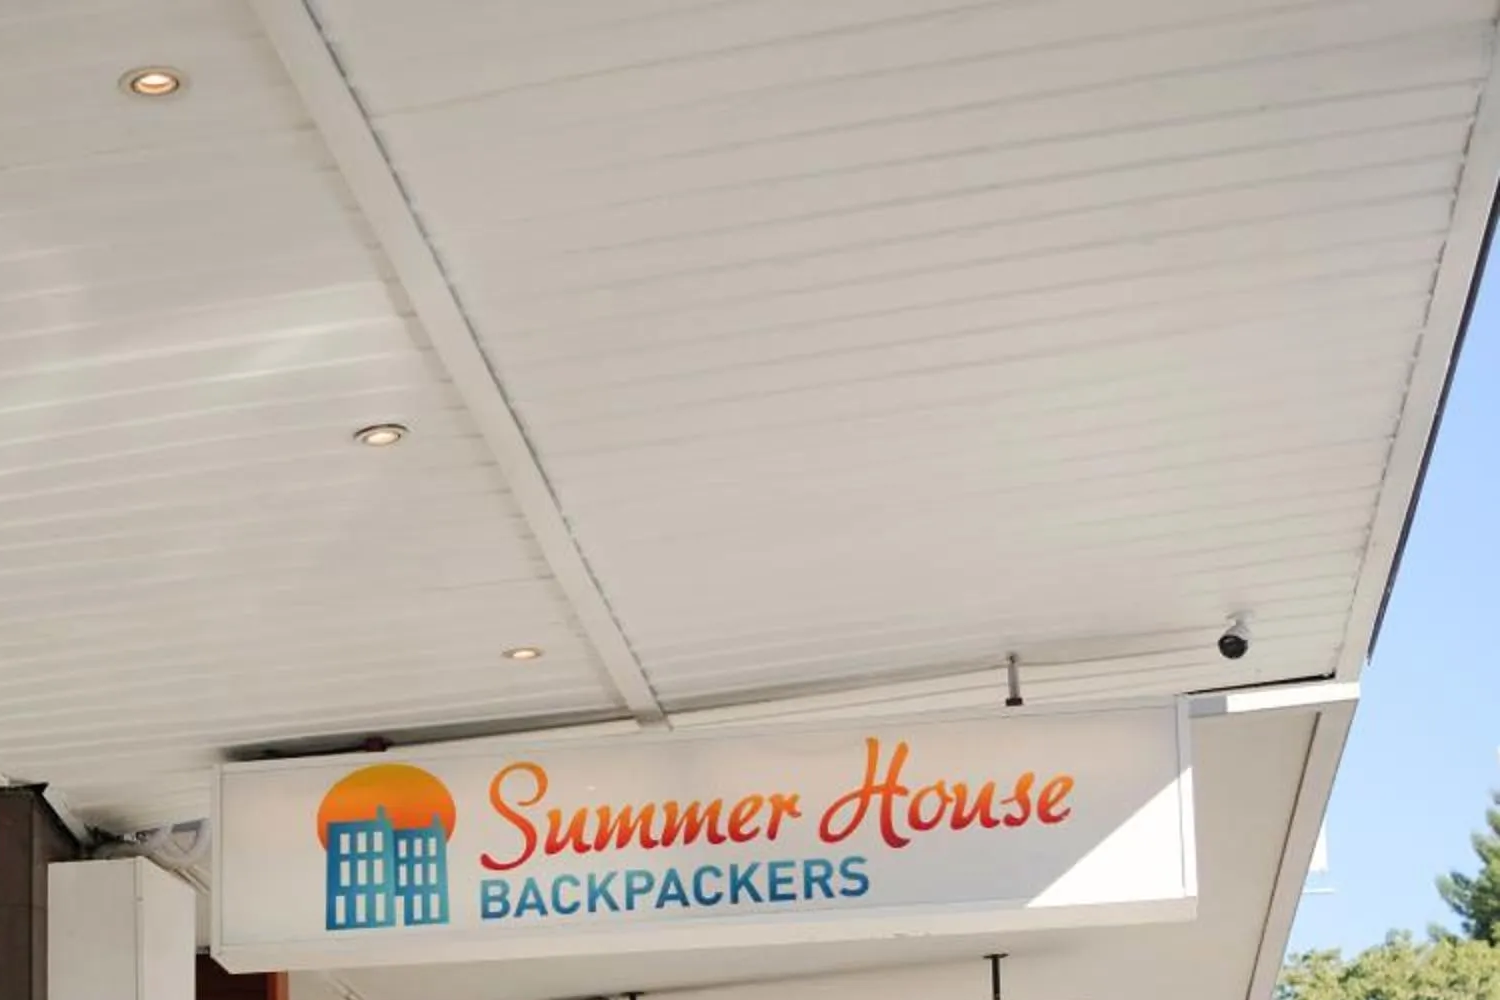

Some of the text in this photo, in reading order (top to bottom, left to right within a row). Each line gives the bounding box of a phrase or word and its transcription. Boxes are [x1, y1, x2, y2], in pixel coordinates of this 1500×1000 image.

[479, 736, 1076, 872] Summer House
[481, 857, 870, 919] BACKPACKERS
